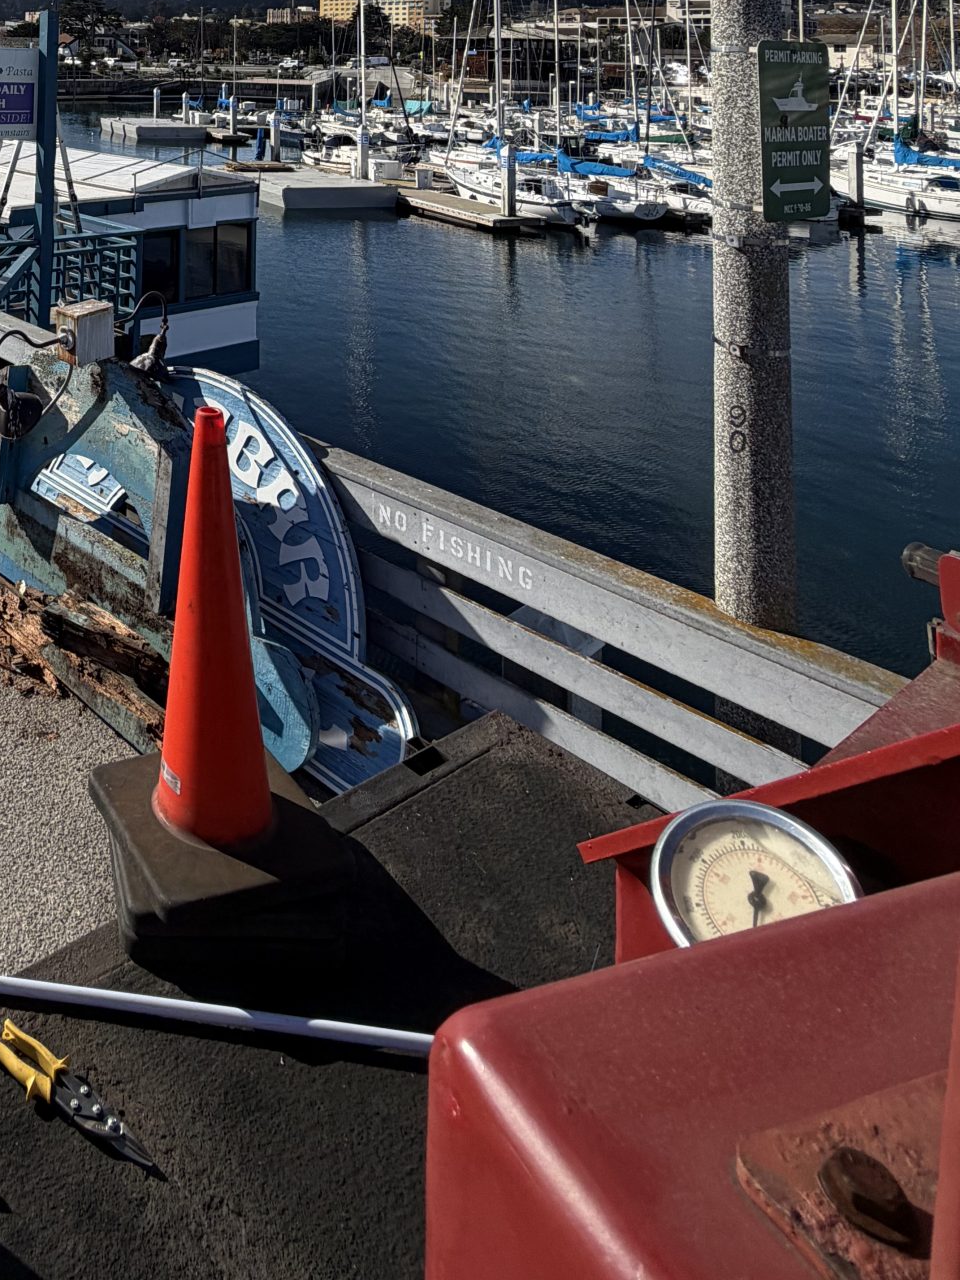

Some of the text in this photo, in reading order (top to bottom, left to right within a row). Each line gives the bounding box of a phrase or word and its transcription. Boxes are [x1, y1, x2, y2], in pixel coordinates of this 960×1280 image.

[765, 50, 822, 64] PERMIT PARKING
[5, 66, 33, 77] Pasta
[764, 126, 827, 142] MARINA BOATER
[772, 150, 821, 167] PERMIT ONLY
[378, 504, 533, 590] NO FISHING
